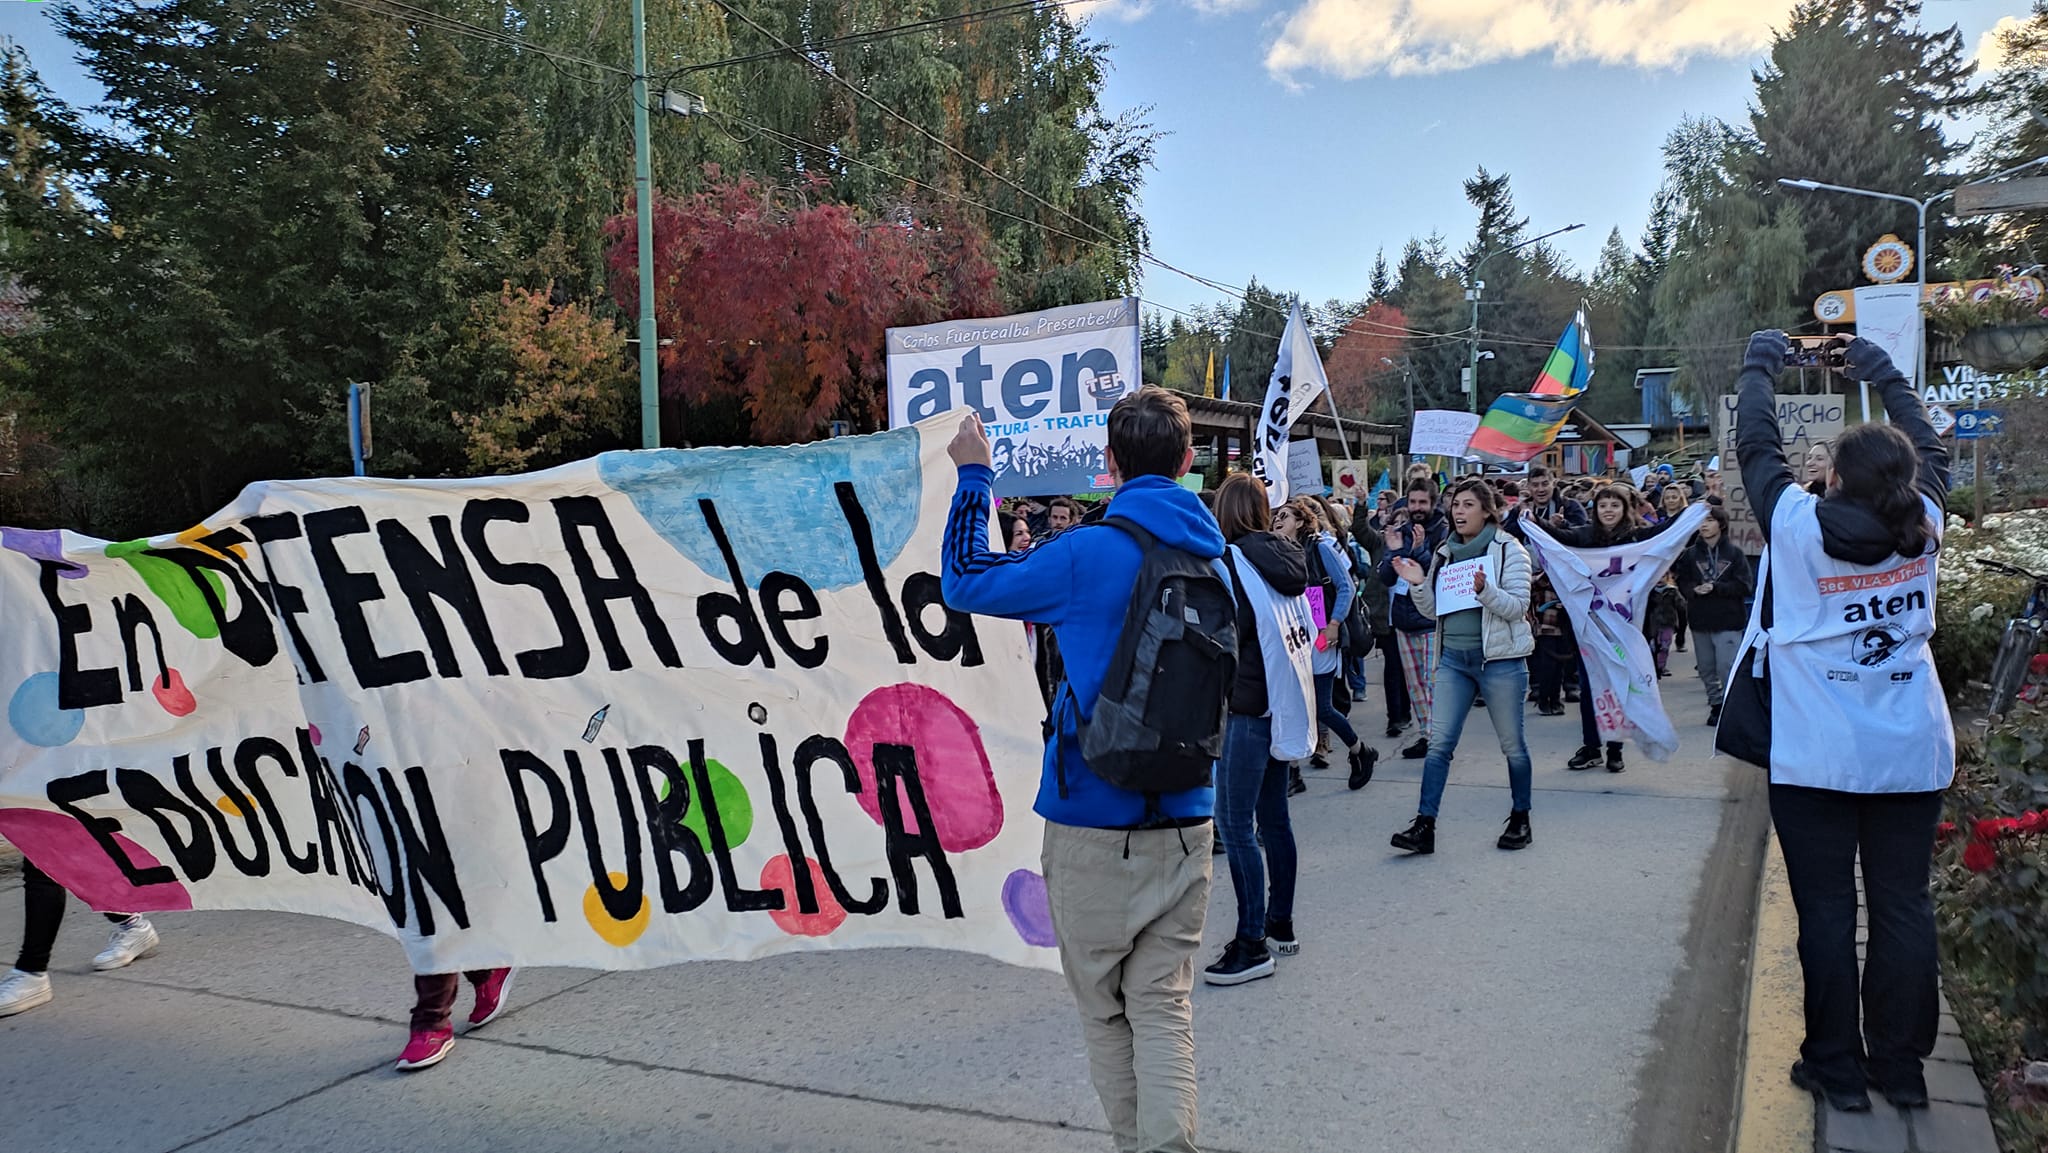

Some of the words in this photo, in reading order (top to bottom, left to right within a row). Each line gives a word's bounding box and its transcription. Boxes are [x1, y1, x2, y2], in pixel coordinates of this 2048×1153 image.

[1823, 306, 1839, 316] 64
[903, 335, 939, 349] Carlos
[946, 326, 1030, 344] Fuentealba
[907, 345, 1118, 426] aten
[984, 420, 1030, 438] STURA
[1043, 413, 1108, 430] TRAFU
[1777, 401, 1842, 425] ARCHO
[35, 557, 171, 710] En
[696, 497, 829, 669] de
[833, 481, 985, 667] la
[1844, 590, 1926, 623] aten
